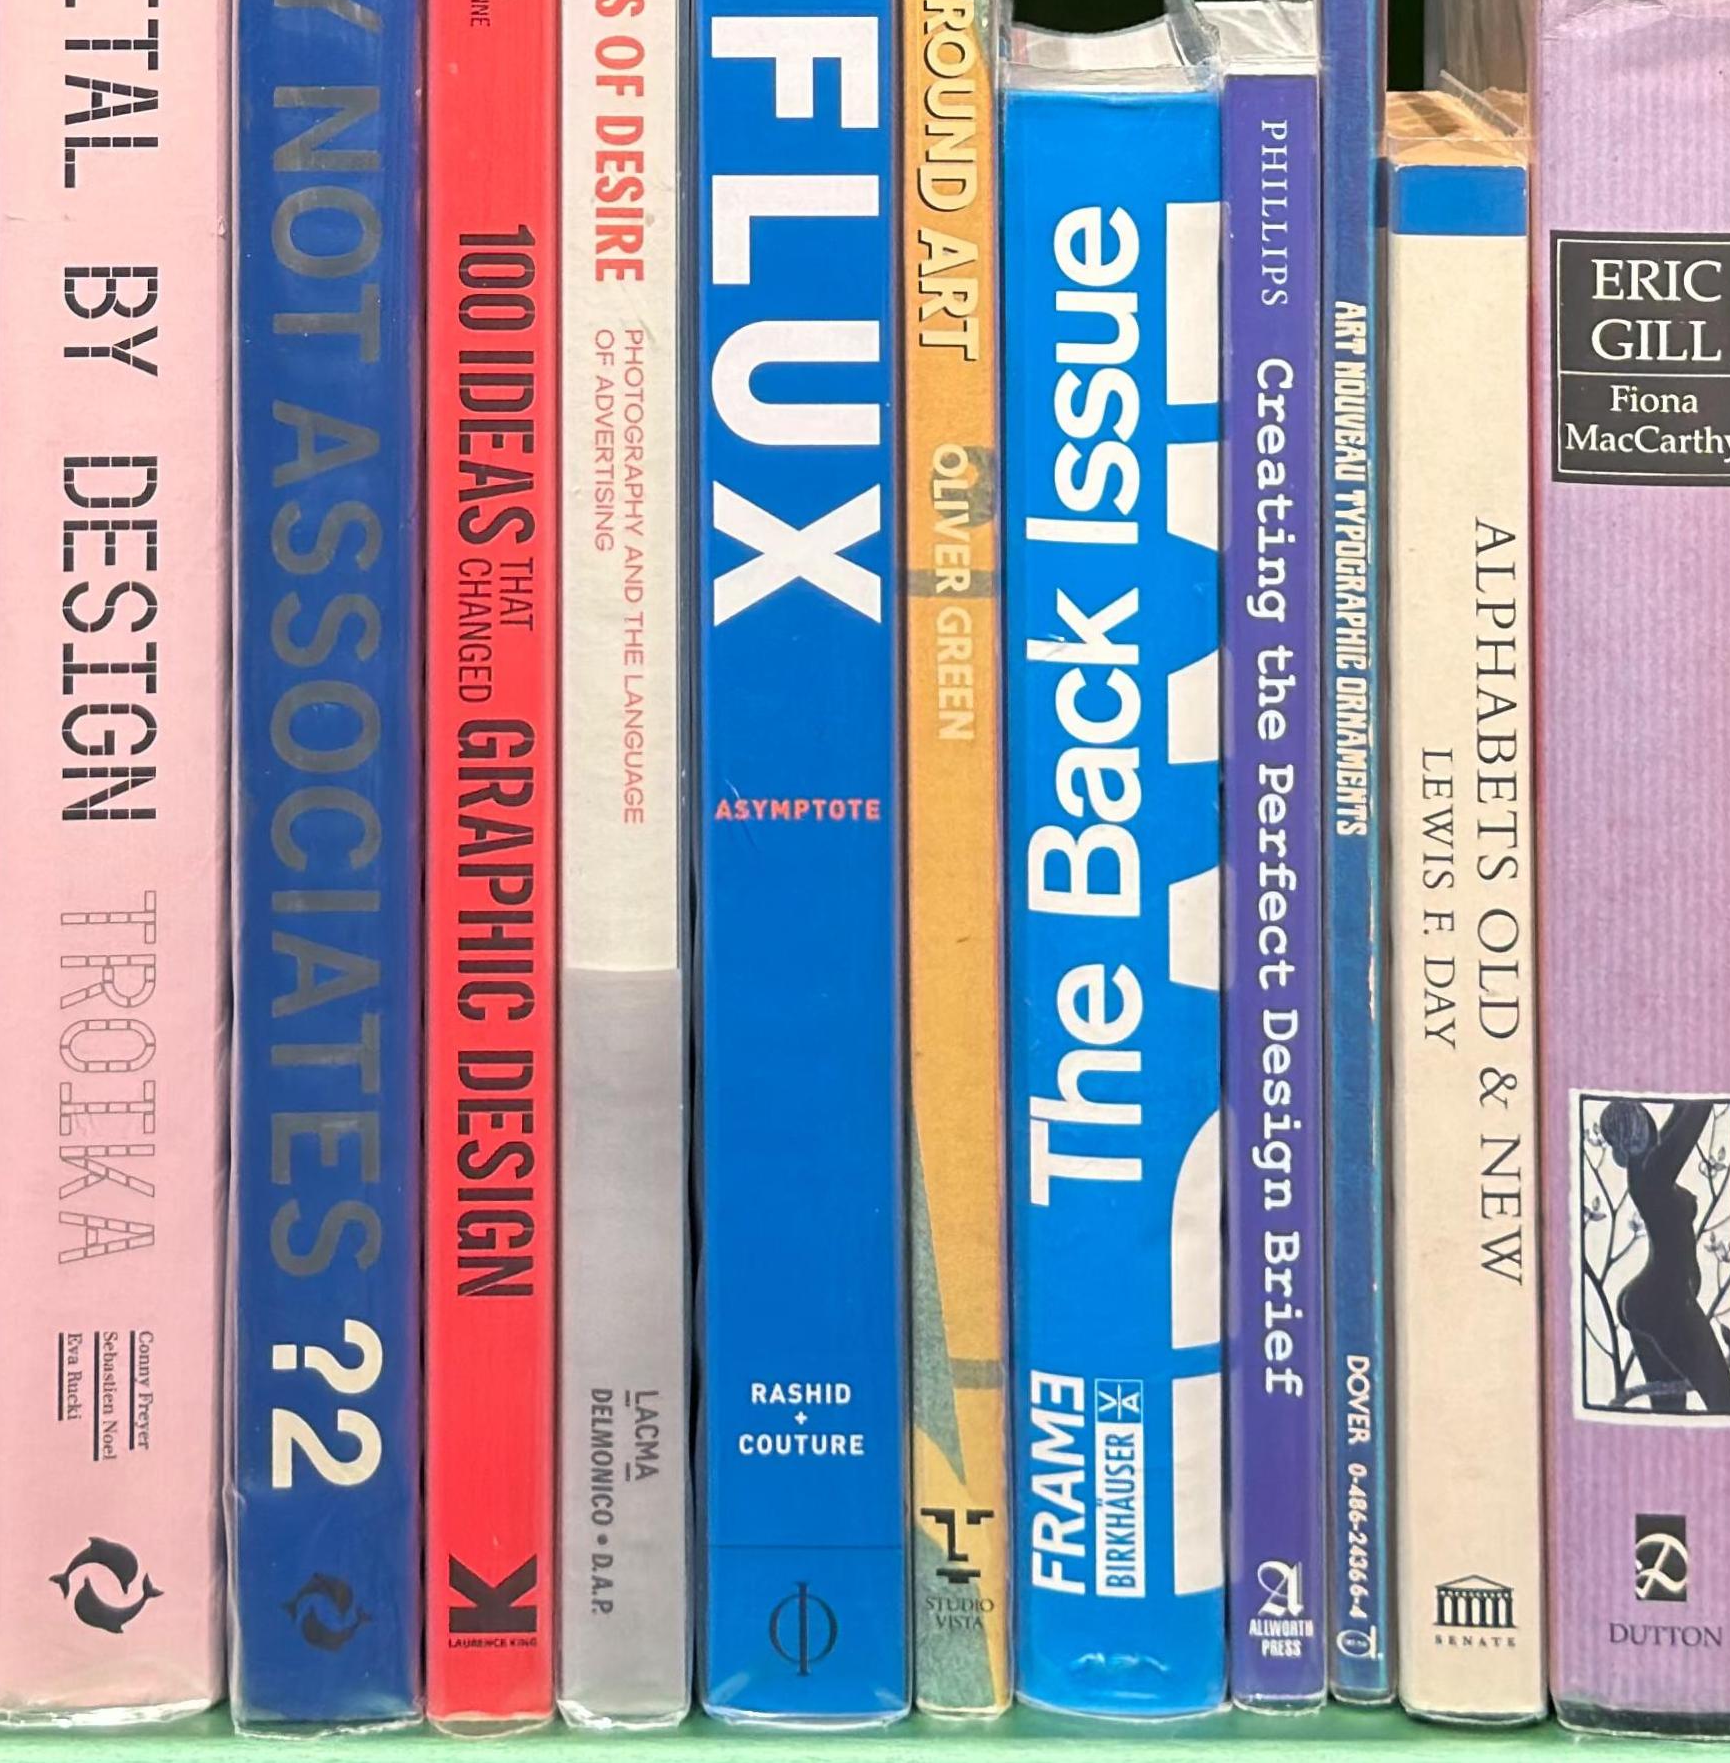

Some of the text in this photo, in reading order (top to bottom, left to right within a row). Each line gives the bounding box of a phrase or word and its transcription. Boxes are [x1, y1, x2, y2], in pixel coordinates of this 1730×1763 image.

[596, 38, 645, 95] OF
[271, 83, 383, 364] NOT
[595, 116, 644, 284] DESIRE
[63, 264, 158, 378] BY
[710, 15, 881, 625] FLUX
[916, 230, 979, 361] ART
[1335, 301, 1366, 355] ART
[1590, 258, 1721, 303] ERIC
[1590, 320, 1721, 363] GILL
[457, 225, 536, 544] 100 IDEAS
[594, 329, 615, 552] OF ADVERTISING
[1335, 361, 1366, 481] NOUVEAU
[1609, 384, 1698, 414] Fiona
[624, 329, 644, 824] PHOTOGRAPHY AND THE LANGUAGE
[929, 443, 971, 595] OLIVER
[1335, 490, 1367, 669] TYPOGRAPHIC
[62, 456, 158, 821] DESIGN
[456, 558, 493, 703] CHANGED
[500, 556, 534, 630] THAT
[937, 608, 972, 739] GREEN
[1025, 204, 1142, 1204] The Back Issue
[715, 797, 881, 822] ASYMPTOTE
[1246, 120, 1302, 1397] PHILLIPS Creating the Perfect Design Brief
[1336, 677, 1367, 836] ORNAMENTS
[271, 400, 383, 1280] ASSOCIATES
[1422, 747, 1457, 1048] LEWIS F. DAY
[1476, 517, 1522, 1285] ALPHABETS OLD & NEW
[456, 719, 535, 1299] GRAPHIC DESIGN
[57, 890, 156, 1264] TROIKA
[67, 1333, 82, 1420] Eva Rucki
[102, 1331, 118, 1415] Sebastien
[134, 1330, 154, 1450] Conny Freyer
[635, 1390, 659, 1481] LACMA
[750, 1380, 852, 1406] RASHID
[1347, 1355, 1370, 1443] DOVER
[591, 1388, 613, 1615] DELMONICO D.A.P.
[738, 1431, 864, 1457] COUTURE
[1097, 1433, 1135, 1588] BIRKHÄUSER
[926, 1597, 994, 1629] STUDIO VISTA
[1249, 1619, 1314, 1637] ALLWORTH
[1262, 1640, 1301, 1657] PRESS
[1435, 1636, 1515, 1647] SENATE
[1609, 1623, 1722, 1647] DUTTON
